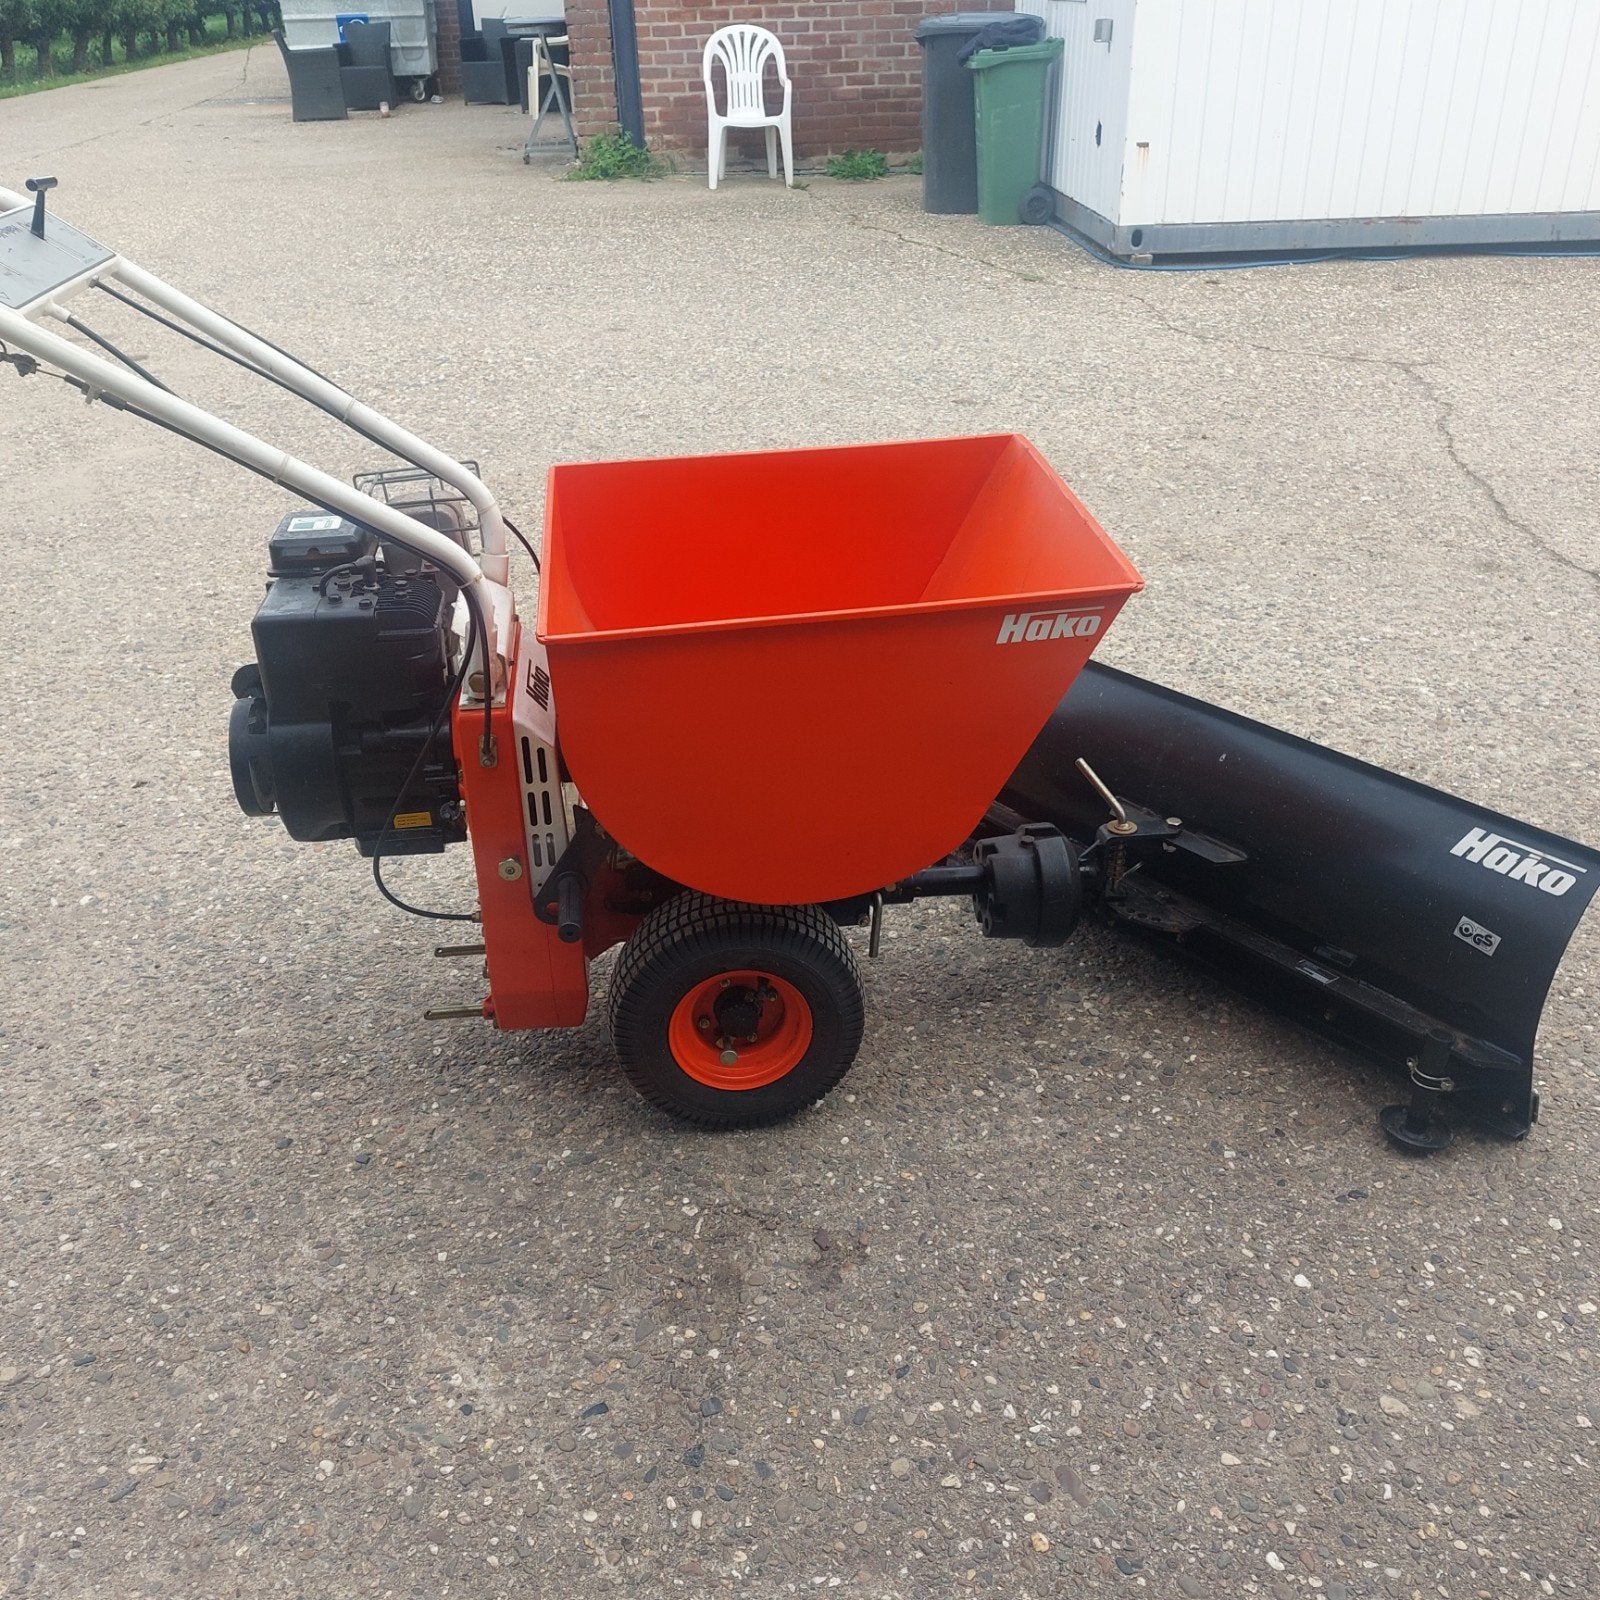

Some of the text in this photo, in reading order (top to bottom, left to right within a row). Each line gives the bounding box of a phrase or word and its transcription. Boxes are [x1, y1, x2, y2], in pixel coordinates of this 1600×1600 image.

[995, 606, 1105, 645] Hako
[526, 658, 550, 713] Hako
[1449, 826, 1588, 897] Hako
